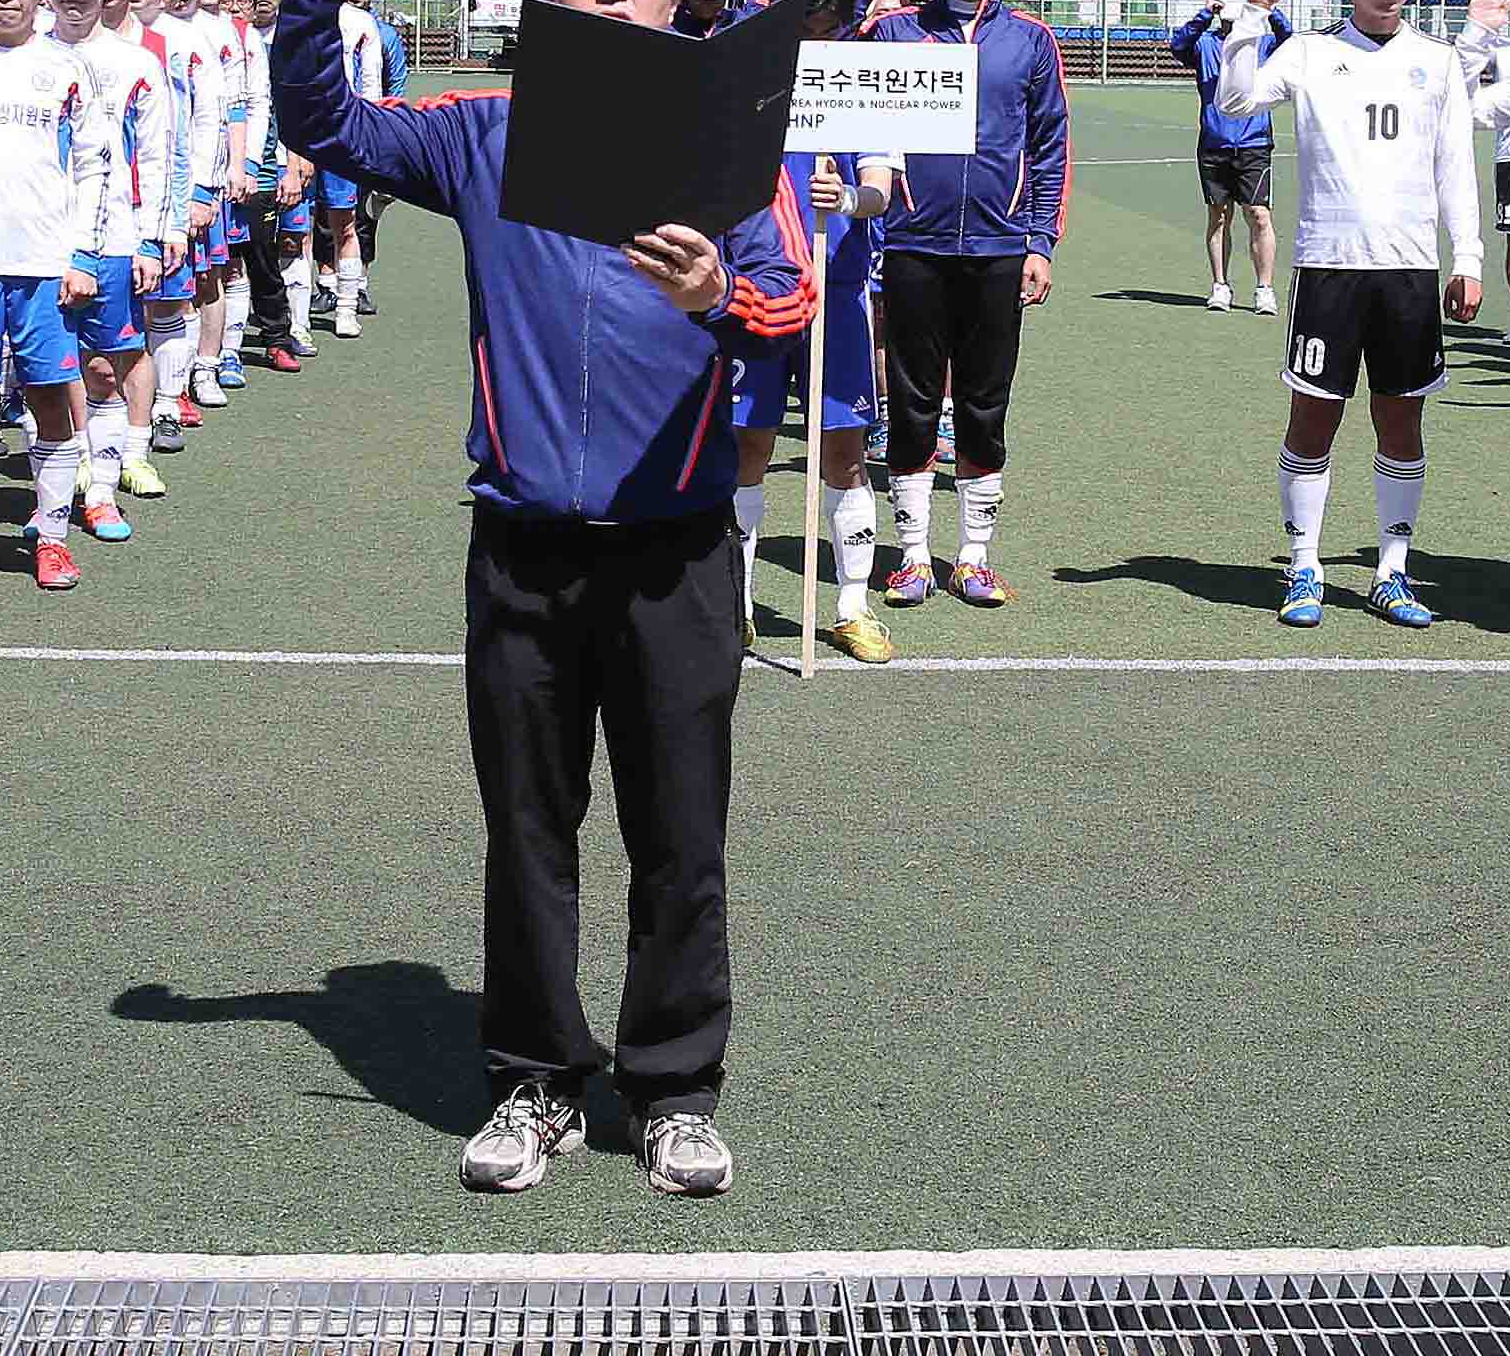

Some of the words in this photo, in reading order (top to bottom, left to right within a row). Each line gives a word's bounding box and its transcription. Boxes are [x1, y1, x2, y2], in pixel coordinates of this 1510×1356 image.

[794, 68, 963, 94] 국수력원자력
[791, 98, 811, 109] REA
[815, 99, 853, 109] HYDRO
[858, 99, 866, 109] &
[870, 99, 920, 110] NUCLEAR
[924, 100, 961, 110] POWER
[787, 114, 825, 129] HNP
[1365, 103, 1399, 141] 10
[1293, 334, 1326, 377] 10
